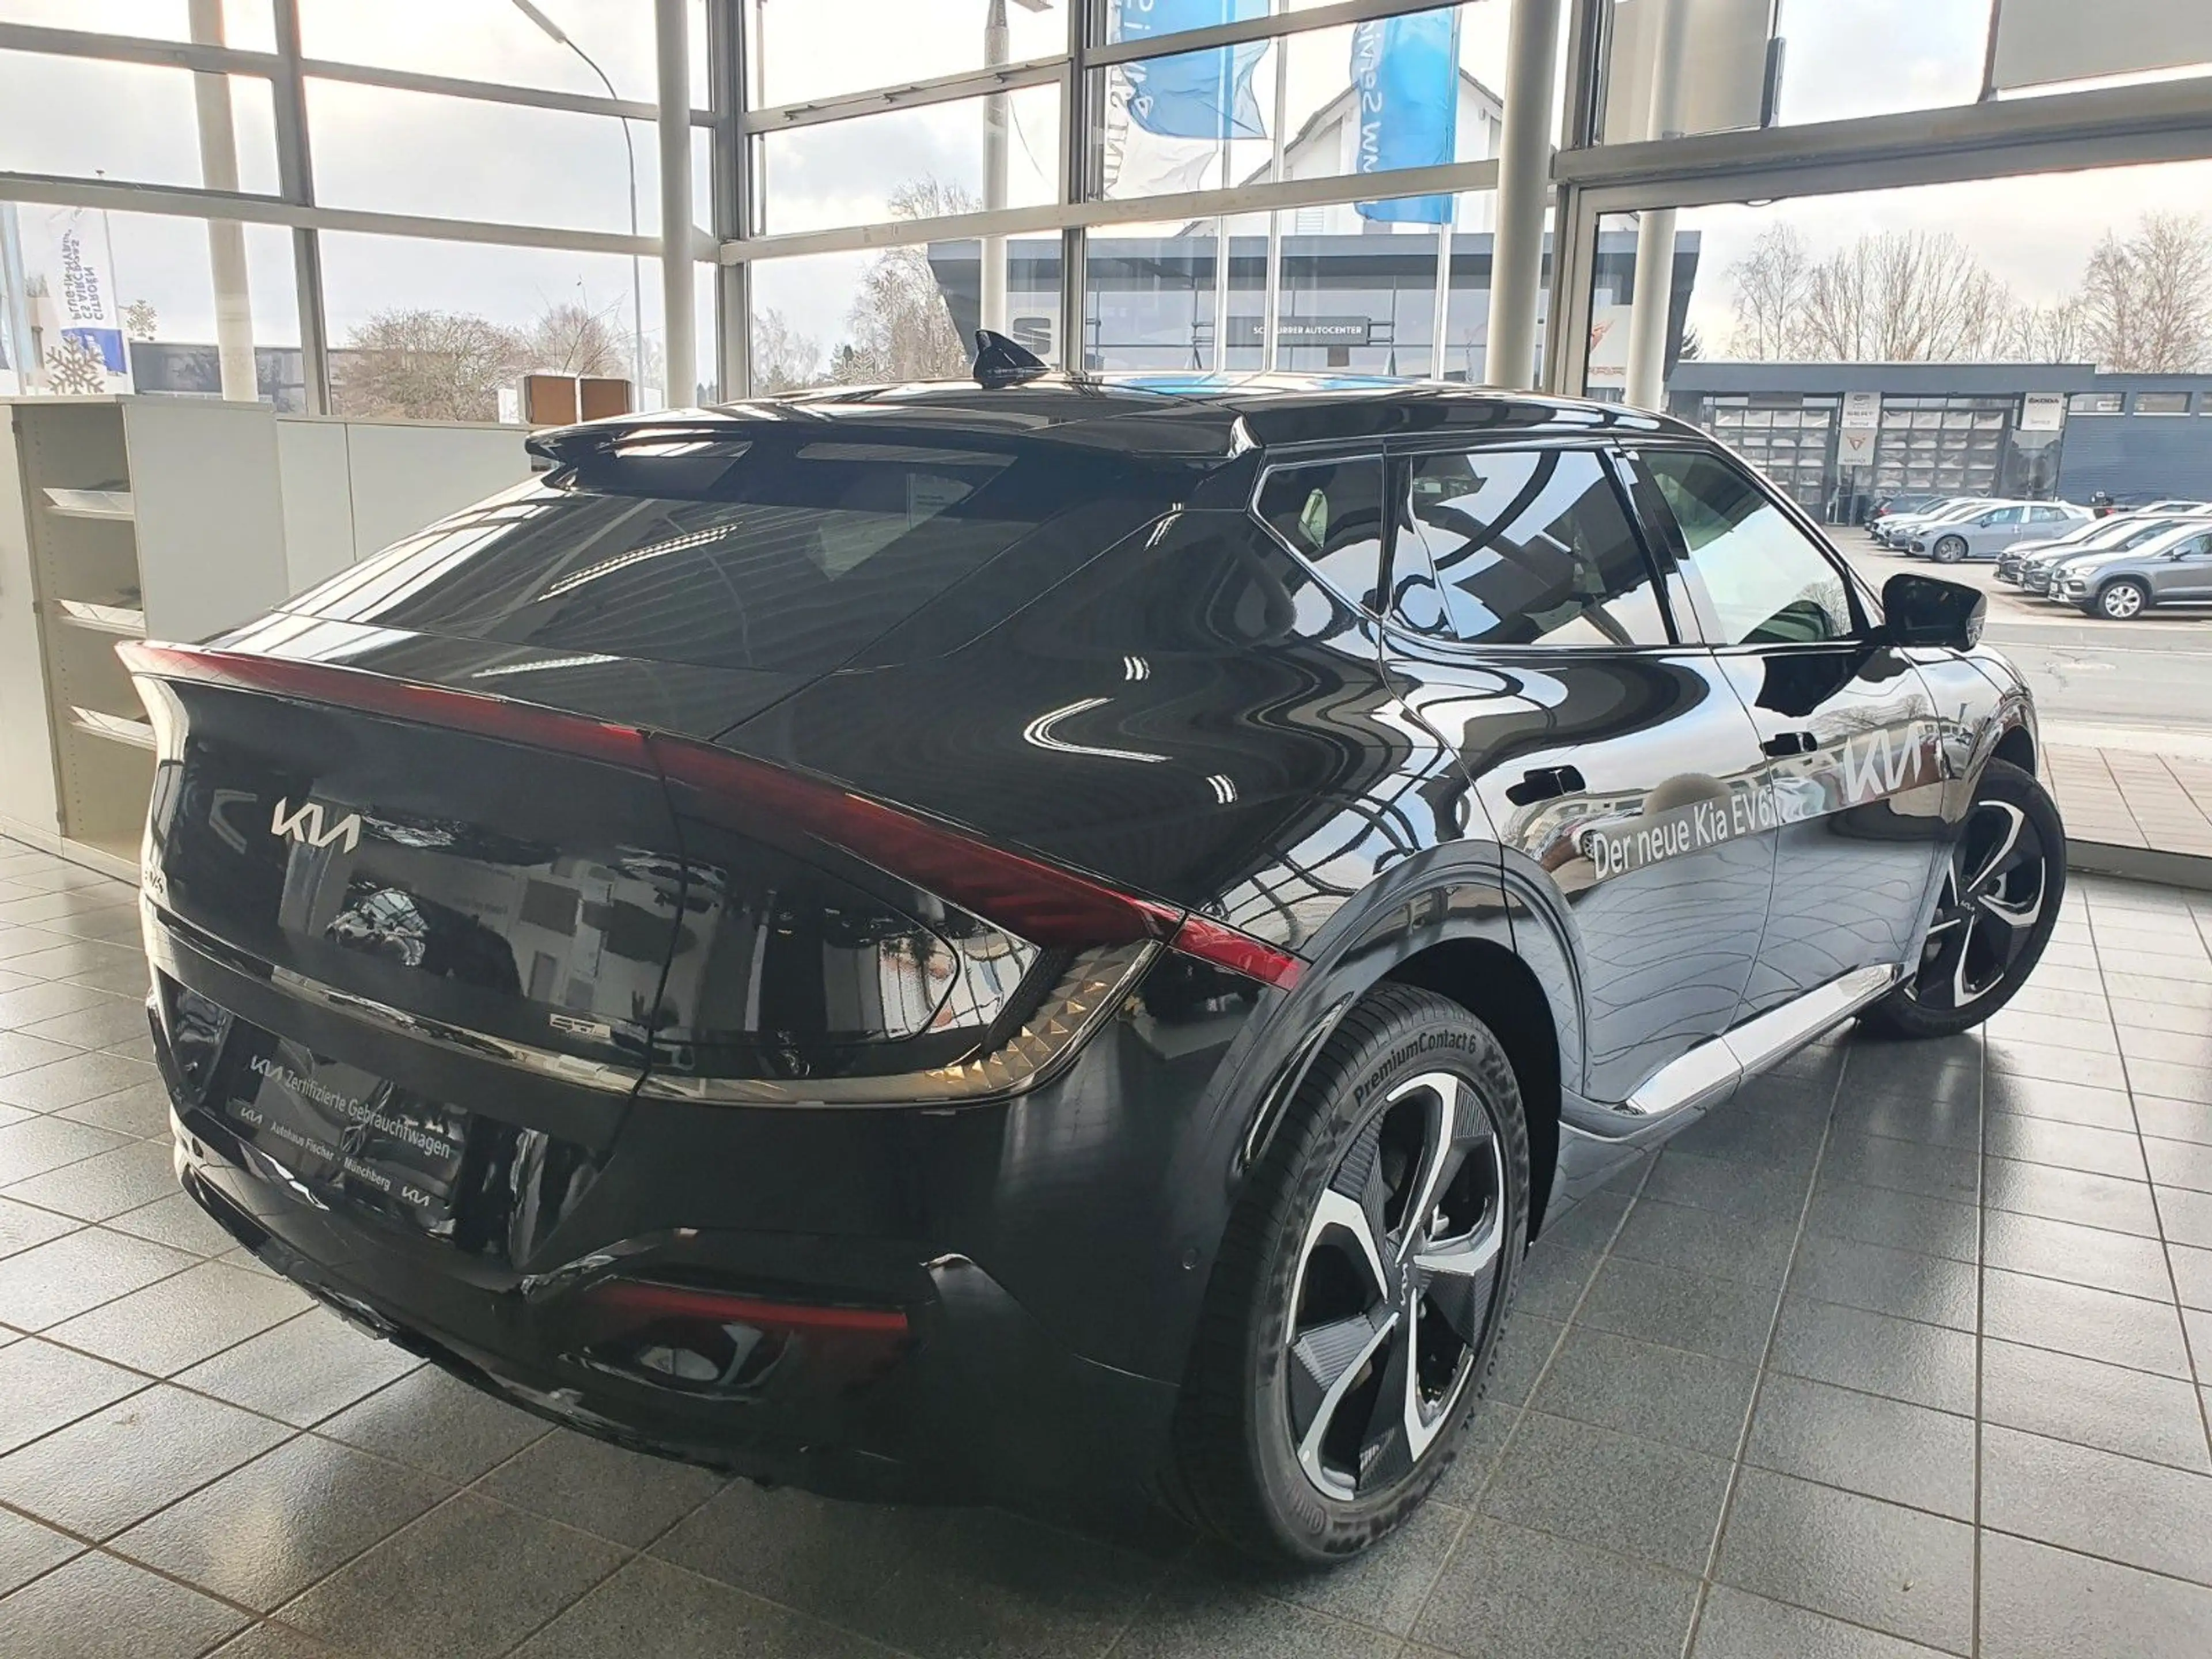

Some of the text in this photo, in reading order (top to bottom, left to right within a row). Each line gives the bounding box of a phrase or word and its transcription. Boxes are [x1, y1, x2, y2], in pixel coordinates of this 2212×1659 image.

[1305, 326, 1362, 335] AUTOCENTER
[1844, 721, 1923, 802] KIA
[271, 796, 360, 854] KIA
[1593, 833, 1631, 880] Der
[1638, 821, 1690, 863] neue
[1694, 801, 1728, 847] Kia
[251, 1055, 450, 1159] KIA Zertifizierte Gebrauchtwagen
[1354, 1029, 1476, 1107] PremiumContact 6
[240, 1107, 430, 1207] KIA Autohaus Fischer Münchberg KIA
